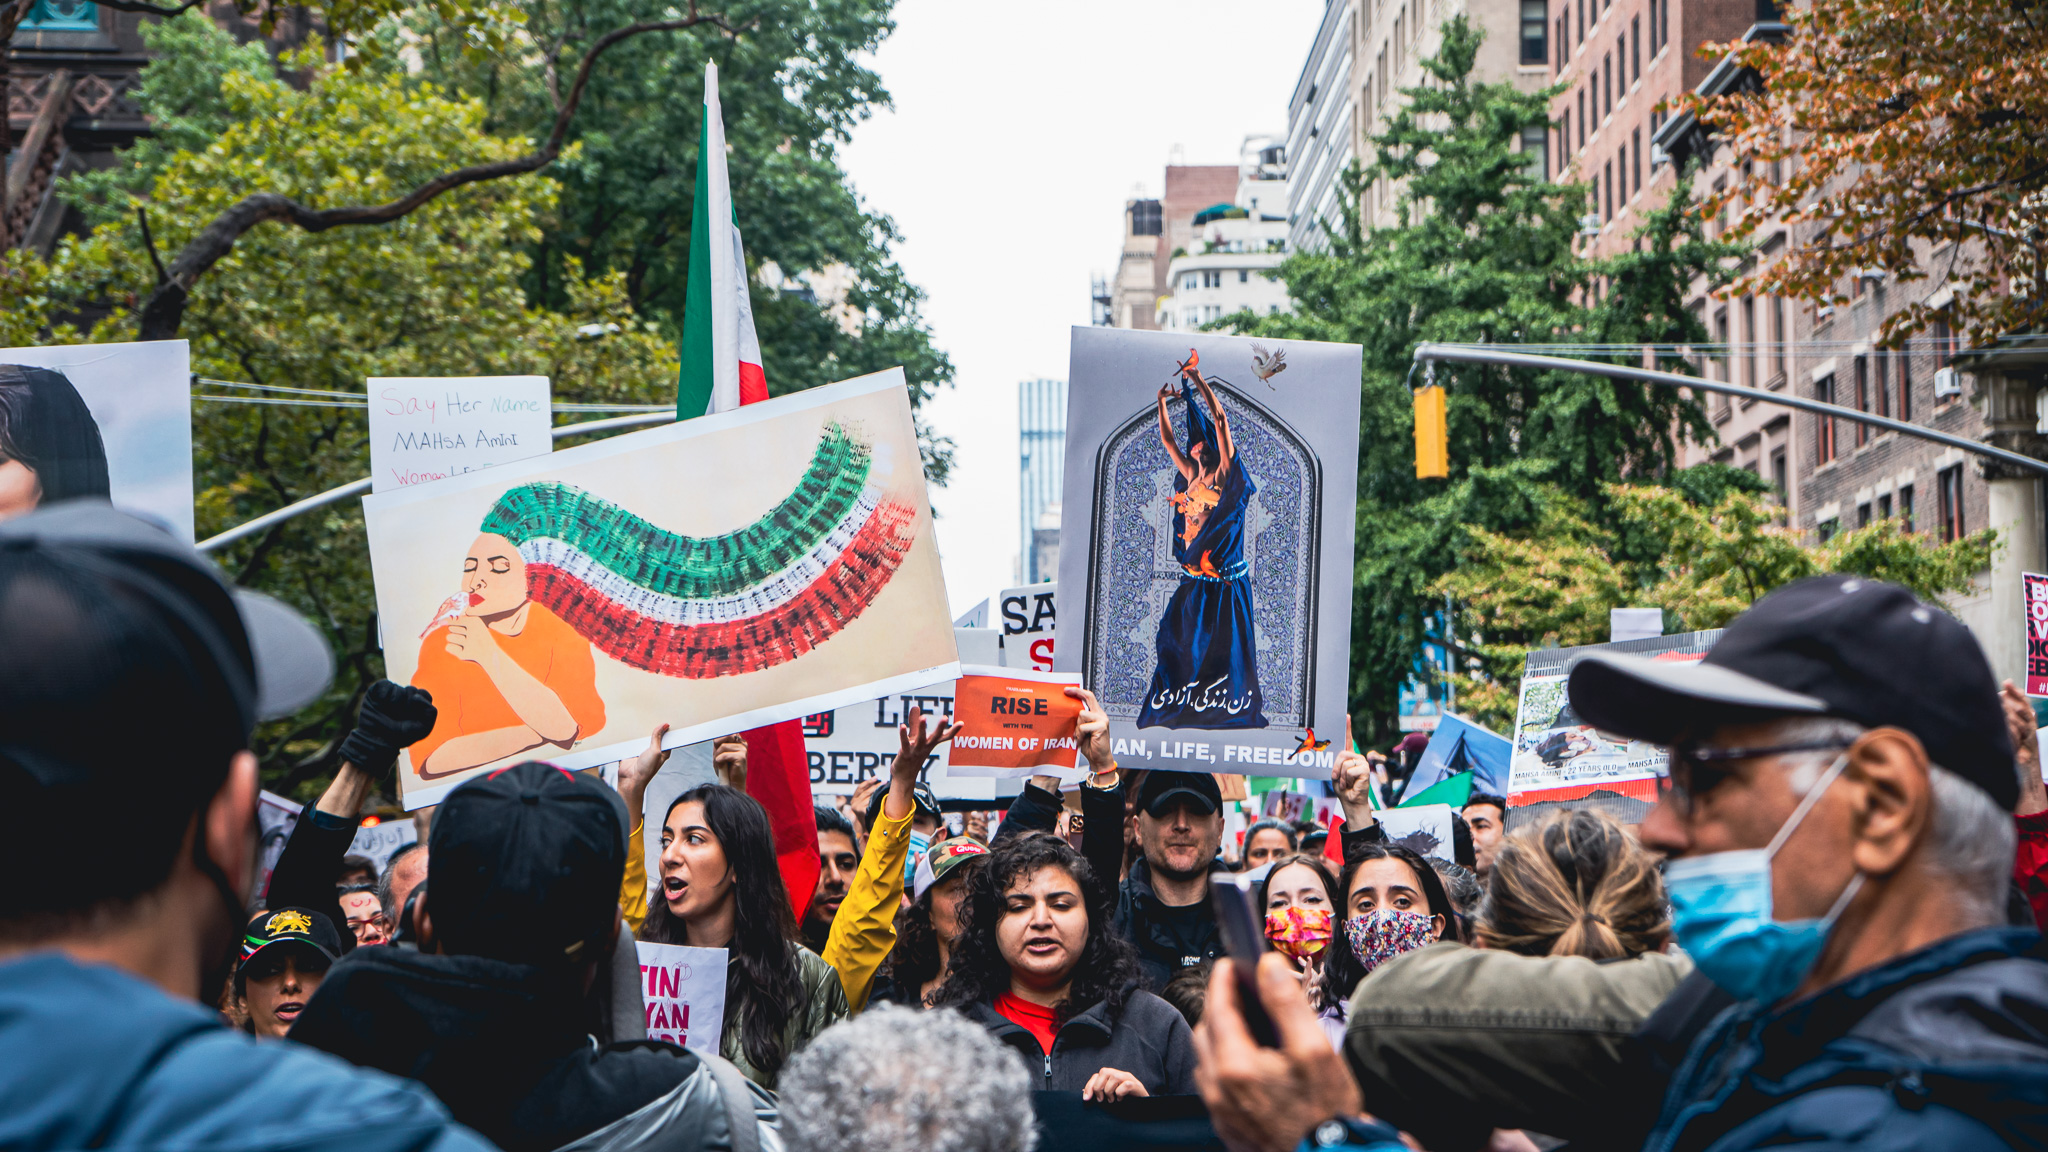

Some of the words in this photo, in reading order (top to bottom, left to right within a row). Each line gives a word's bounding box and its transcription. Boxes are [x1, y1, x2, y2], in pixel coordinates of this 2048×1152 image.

[381, 387, 436, 424] Say
[446, 392, 482, 416] Her
[490, 395, 542, 413] Name
[991, 696, 1048, 716] RISE
[953, 736, 1013, 750] WOMEN
[1018, 738, 1039, 750] OF
[1043, 737, 1077, 750] IRAN
[1110, 738, 1153, 760] AN,
[1160, 740, 1217, 764] LIFE,
[1223, 745, 1334, 768] FREEDOM
[1514, 771, 1539, 780] MAHSA
[1541, 770, 1562, 778] AMINI
[1567, 766, 1577, 775] 22
[1578, 764, 1601, 773] YEARS
[1603, 763, 1618, 772] OLD
[1628, 758, 1653, 769] MAHSA
